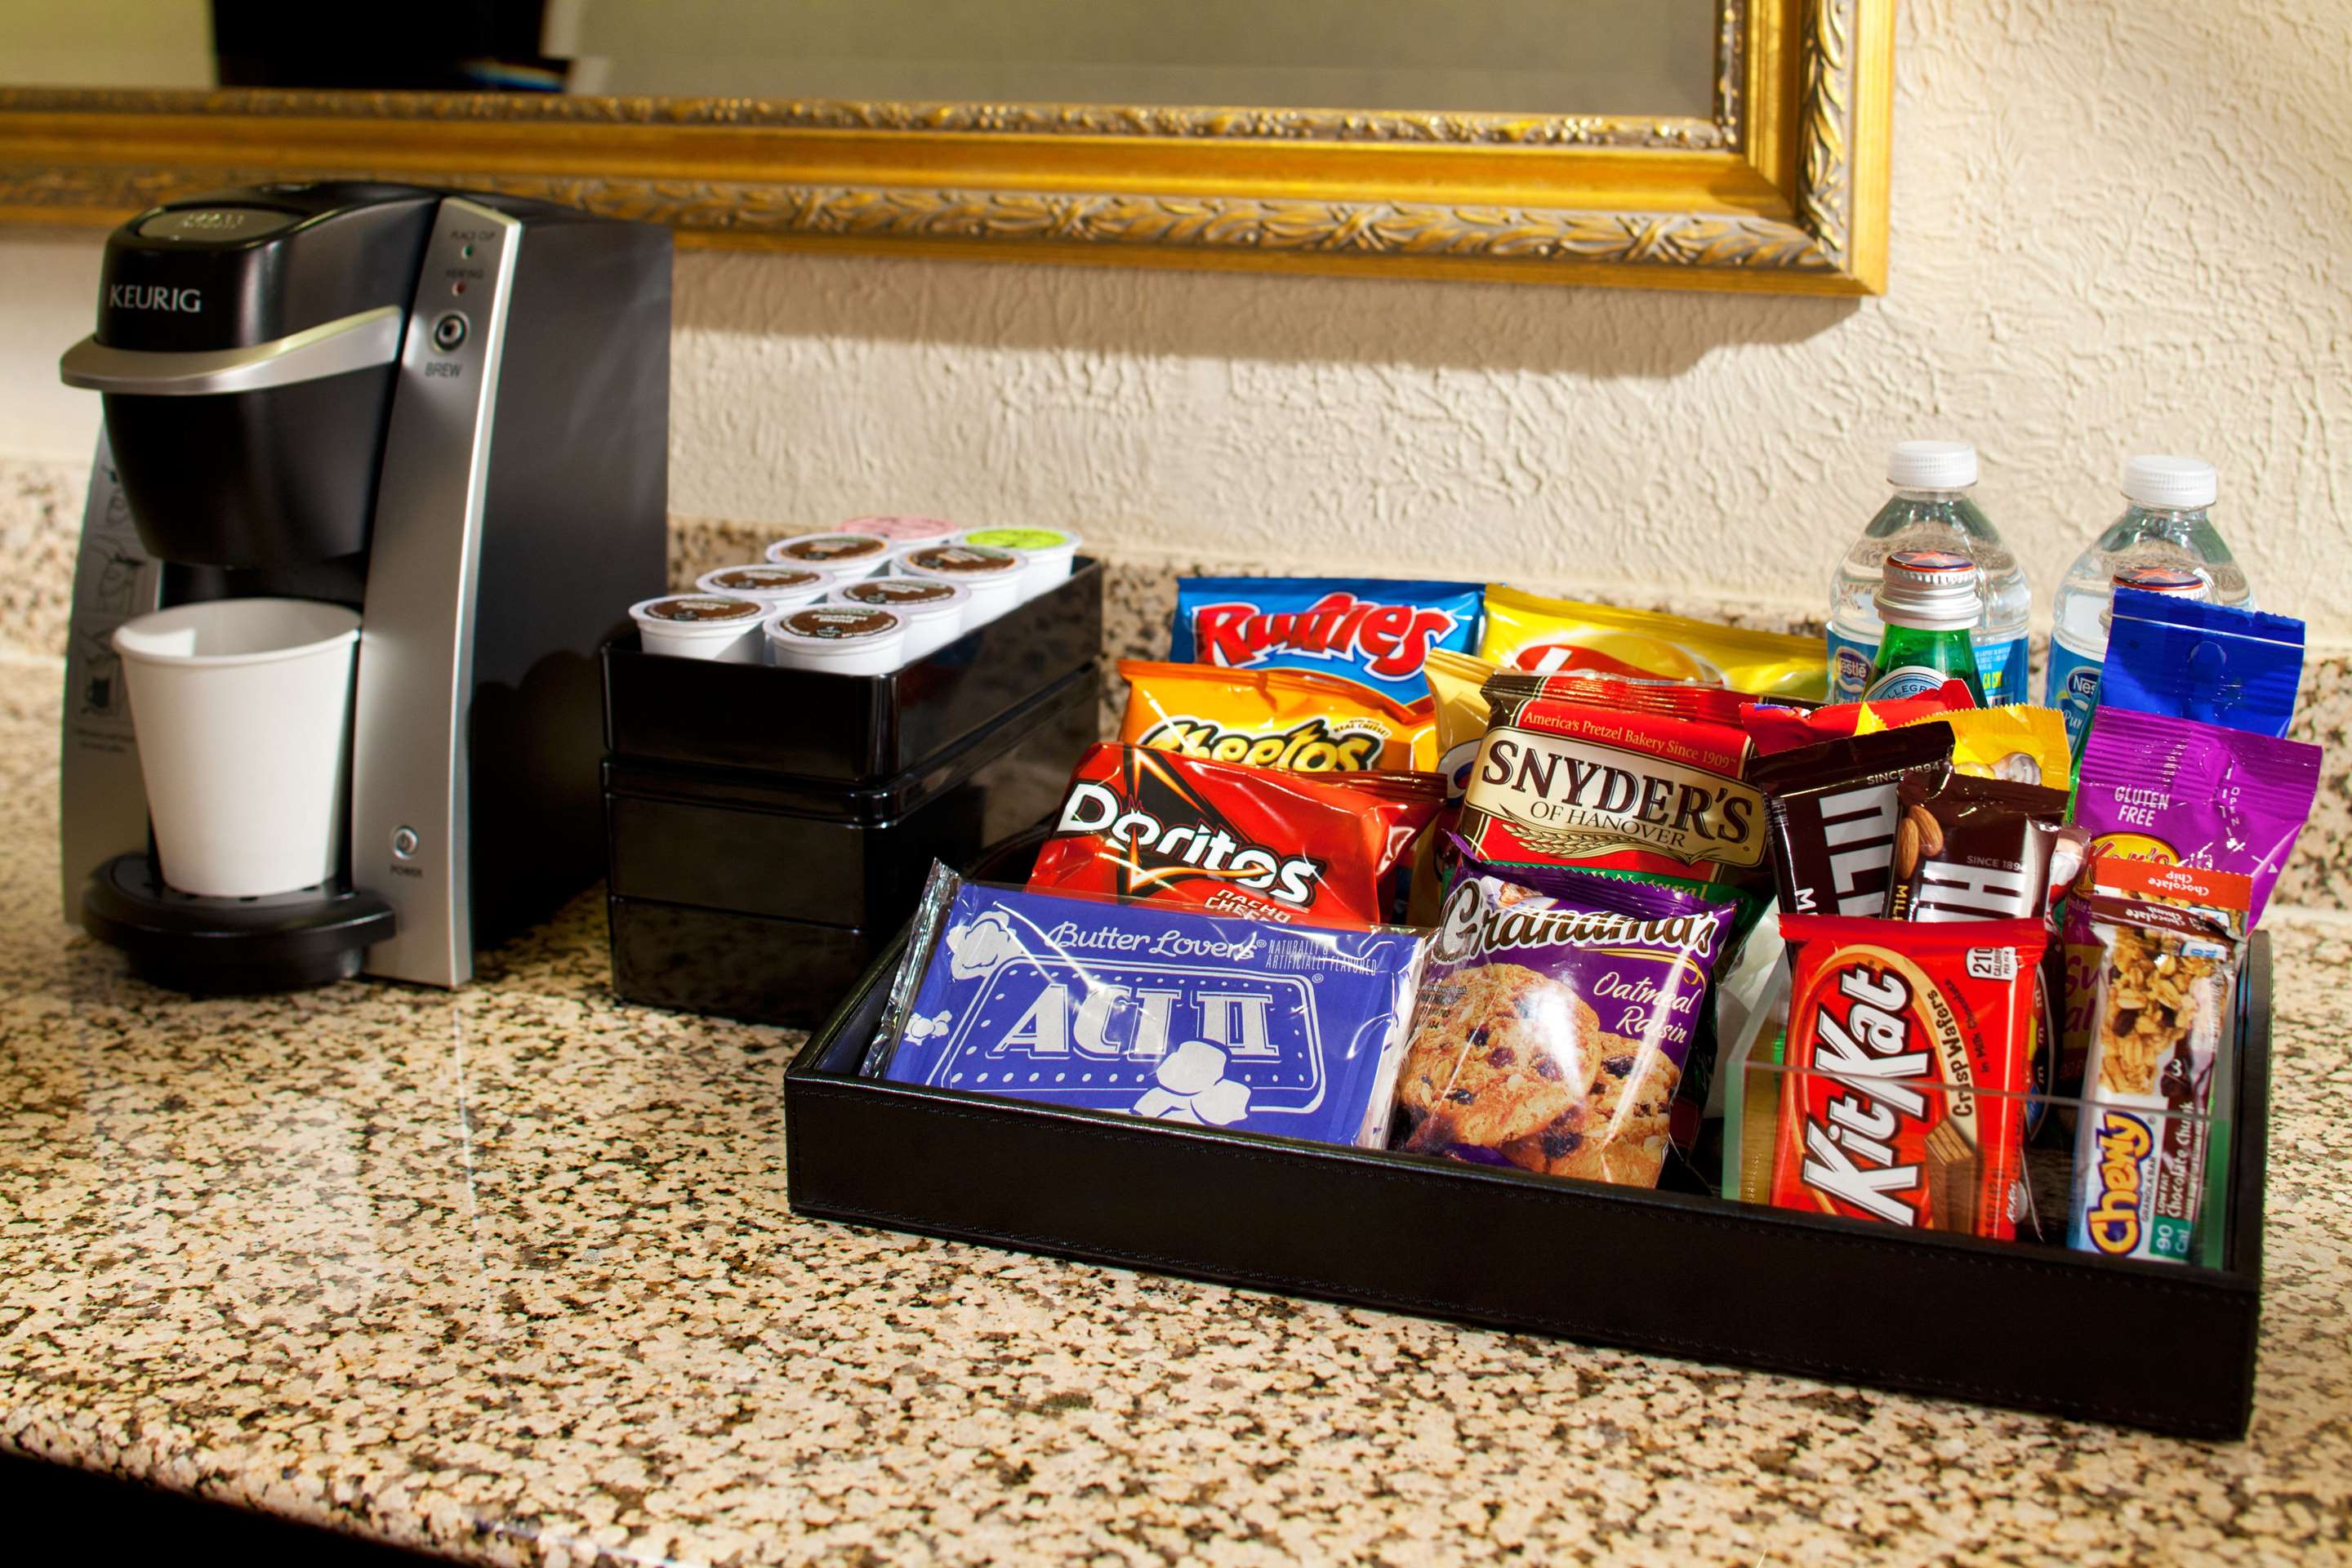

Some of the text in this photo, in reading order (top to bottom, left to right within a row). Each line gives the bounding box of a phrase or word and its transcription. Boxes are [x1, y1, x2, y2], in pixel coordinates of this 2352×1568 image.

[109, 285, 203, 314] KEURIG
[425, 362, 461, 378] BREW
[1192, 593, 1458, 680] Ruffles
[2074, 675, 2098, 694] Nes
[1524, 710, 1579, 733] America's
[1583, 719, 1623, 742] Pretzel
[1623, 729, 1665, 753] Bakery
[1667, 739, 1699, 760] Since
[1481, 739, 1753, 846] SNYDER'S
[1866, 768, 1904, 786] SINCE
[2114, 786, 2170, 810] GLUTEN
[2117, 804, 2156, 827] FREE
[1530, 800, 1686, 849] OF HANOVER
[1057, 782, 1325, 905] Doritos
[1967, 855, 2000, 869] SINCE
[2166, 870, 2194, 884] Chip
[2147, 876, 2210, 897] Chocolate
[1217, 889, 1292, 924] NACHO
[1434, 877, 1719, 963] Grandma's
[1045, 921, 1258, 960] Butter Lovers
[1267, 939, 1321, 956] NATURALLY
[1265, 955, 1330, 971] ARTIFICIALLY
[1592, 971, 1701, 1015] Oatmeal
[985, 982, 1182, 1062] ACT
[1616, 1004, 1688, 1045] Raisin
[1927, 989, 1964, 1060] Wafers
[2087, 1111, 2154, 1256] Chewy
[2167, 1149, 2189, 1218] Chocolate
[2155, 1224, 2173, 1250] 90
[2176, 1228, 2190, 1254] Cal
